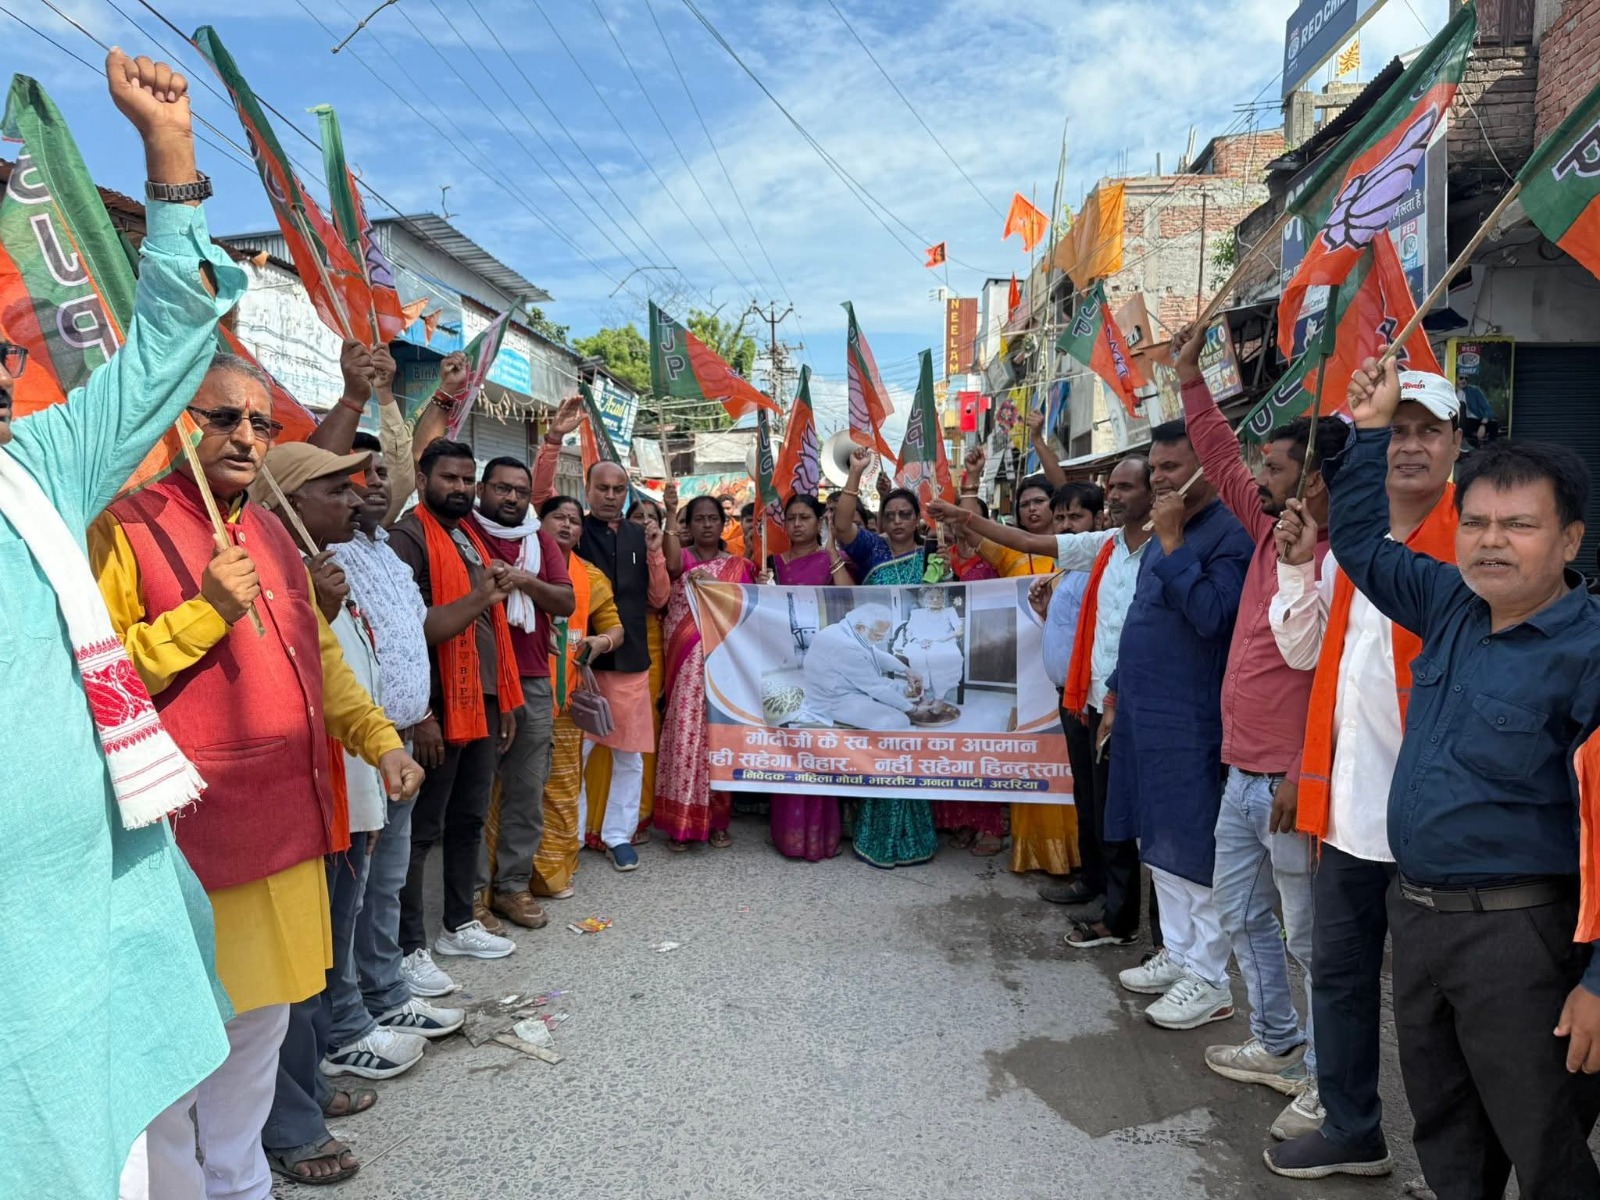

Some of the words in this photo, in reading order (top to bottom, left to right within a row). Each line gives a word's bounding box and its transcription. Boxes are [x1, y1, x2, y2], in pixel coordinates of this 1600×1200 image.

[1301, 9, 1323, 49] RED
[1402, 221, 1416, 235] RED
[949, 299, 960, 374] NEELAM
[413, 366, 438, 379] BIHA
[460, 666, 468, 695] BJP
[745, 728, 814, 749] मोदीजी
[817, 731, 840, 749] के
[843, 736, 873, 751] स्व.
[877, 736, 923, 752] माता
[927, 737, 956, 752] का
[960, 738, 1038, 754] अपमान
[738, 750, 793, 769] सहेगा
[873, 754, 914, 773] नहीं
[917, 756, 976, 775] सहेगा
[794, 771, 833, 783] महिला
[868, 774, 916, 787] भारतीय
[919, 778, 954, 788] जनता
[989, 779, 1039, 791] अररिया
